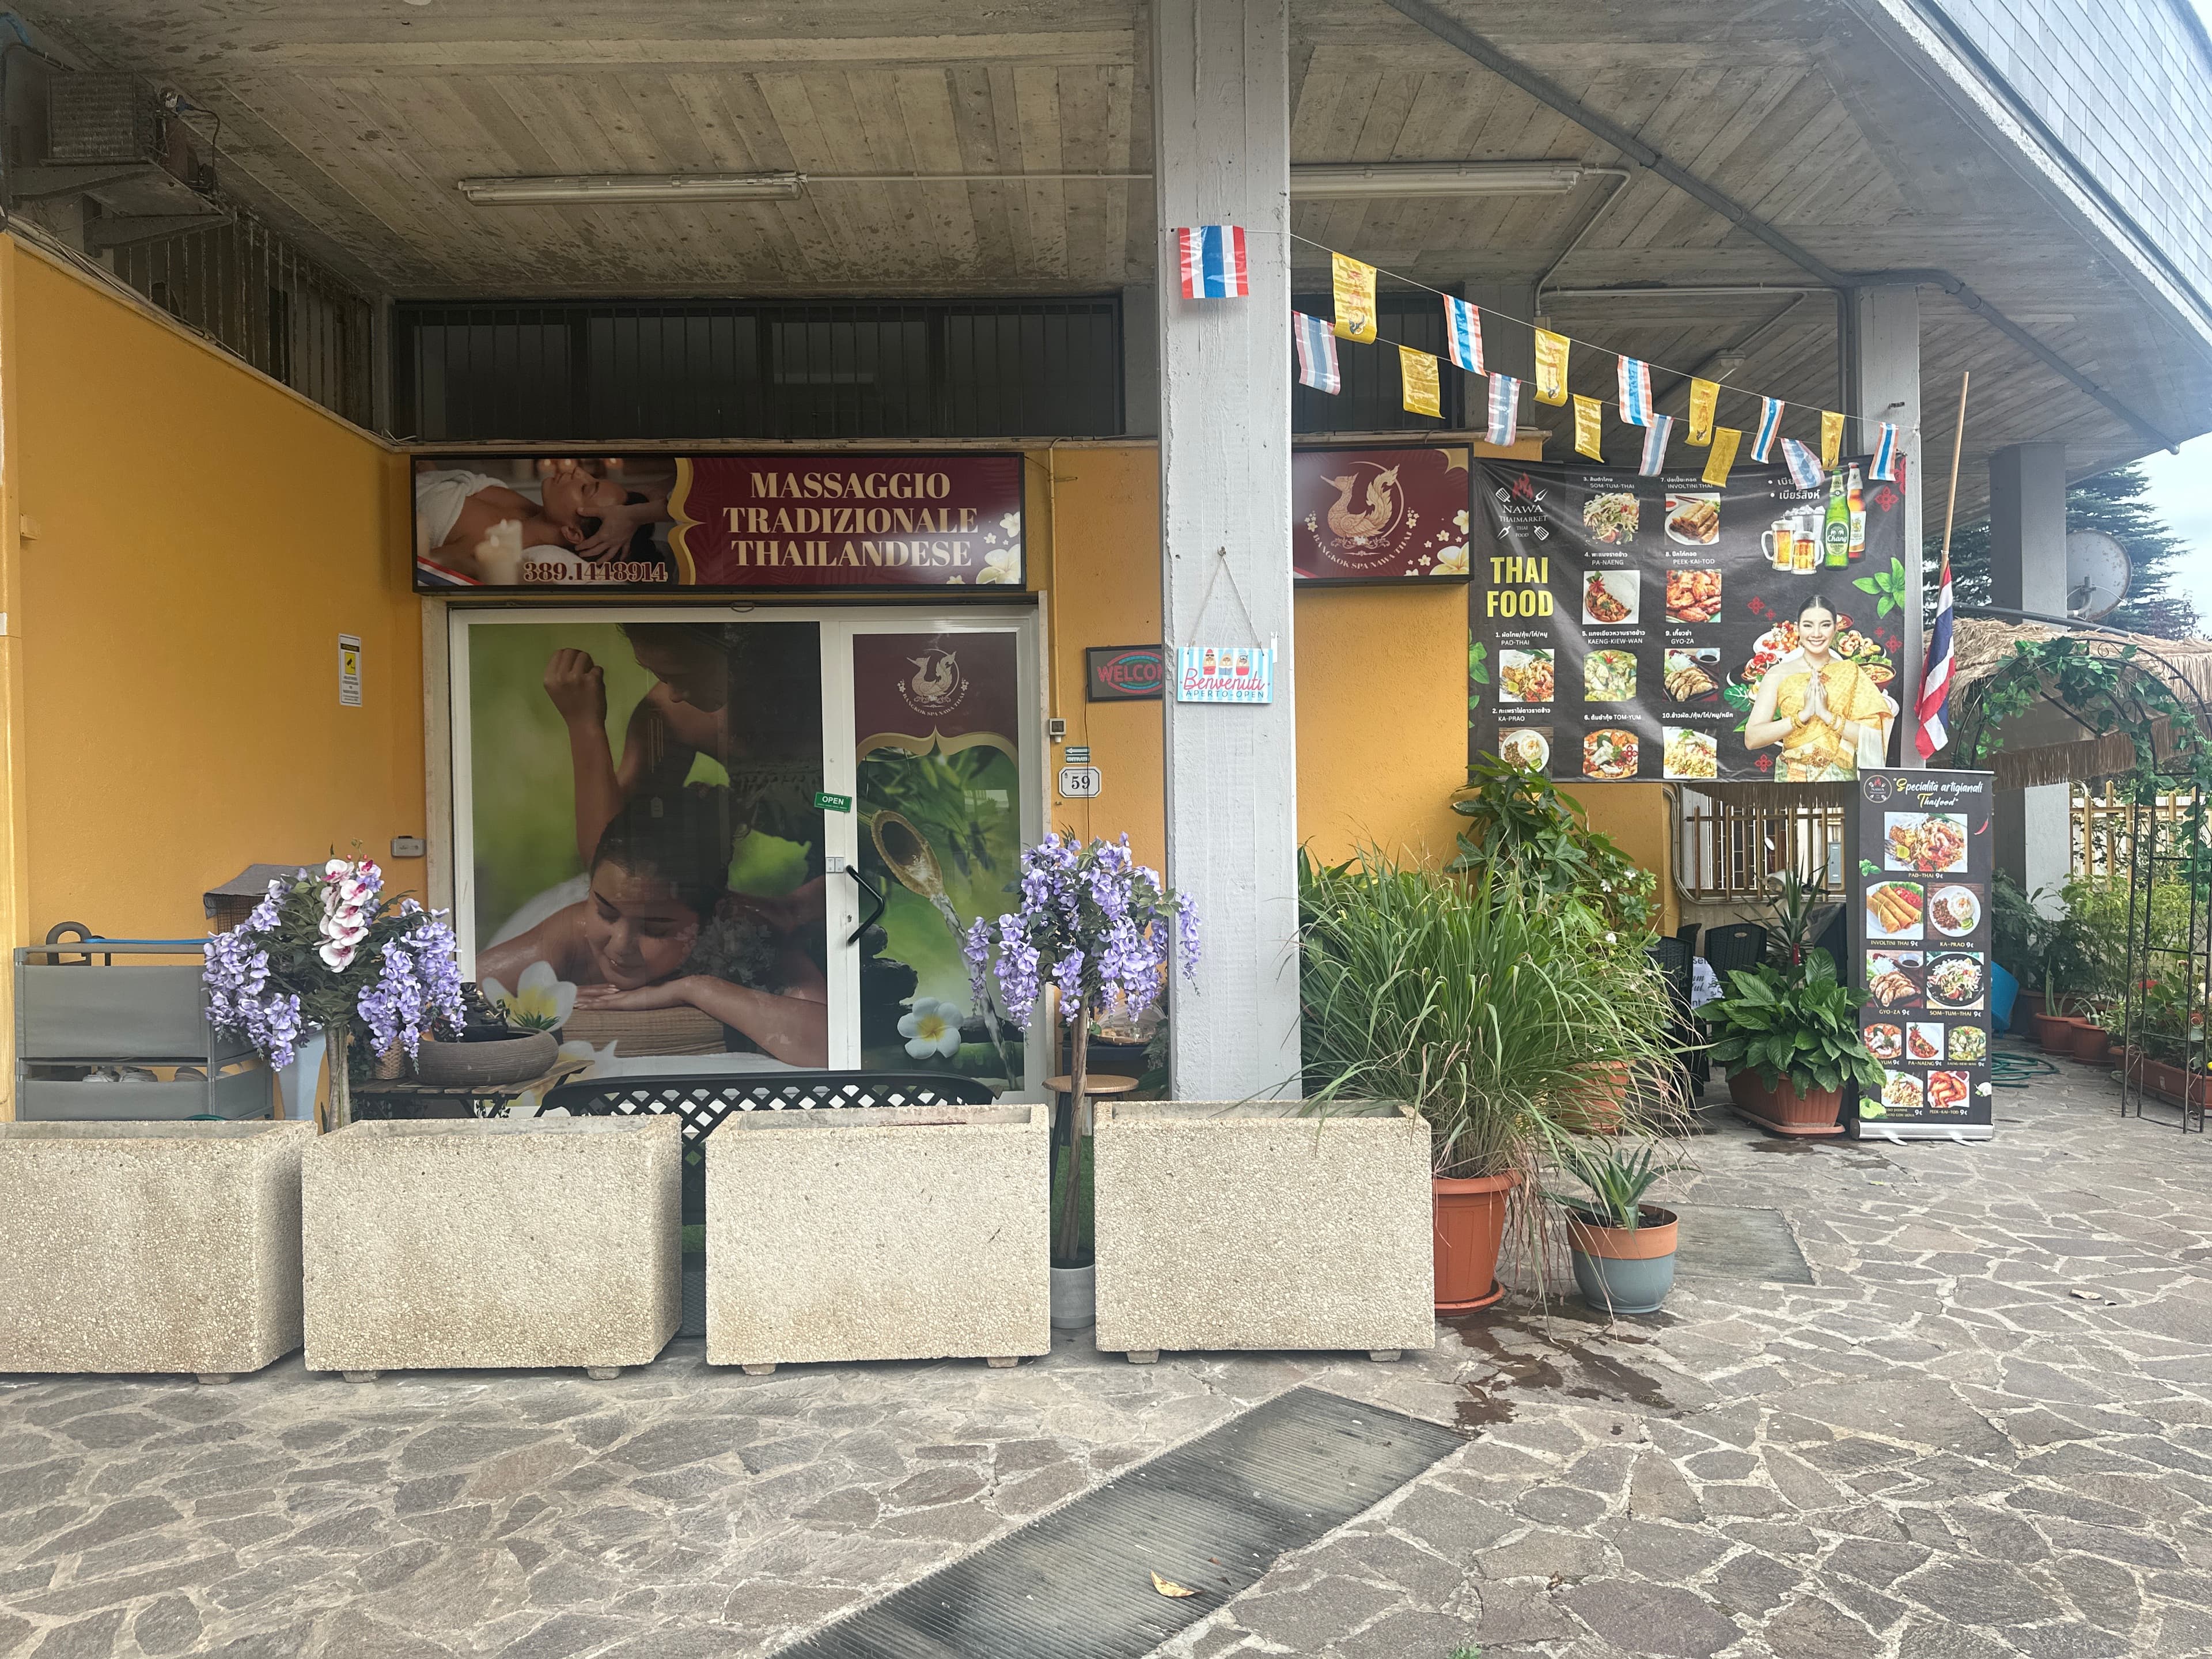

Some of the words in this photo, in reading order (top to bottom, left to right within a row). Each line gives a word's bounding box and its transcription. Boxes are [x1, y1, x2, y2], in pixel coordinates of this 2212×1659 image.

[751, 472, 950, 499] MASSAGGIO
[1779, 488, 1820, 499] เบียร์สิงห์
[1499, 514, 1548, 523] THAIMARKET
[1502, 504, 1543, 514] NAWA
[723, 507, 979, 533] TRADIZIONALE
[1827, 534, 1847, 543] Chang
[730, 540, 972, 567] THAILANDESE
[1313, 533, 1349, 568] BANGKOK
[1370, 554, 1396, 567] NAWA
[1394, 531, 1412, 554] THAI
[524, 562, 668, 582] 389.1448914
[1490, 556, 1548, 584] THAI
[1487, 589, 1554, 618] FOOD
[1183, 668, 1266, 691] Benvenuti
[1071, 775, 1090, 789] 59
[1940, 781, 1983, 796] artigianali
[822, 796, 844, 806] OPEN
